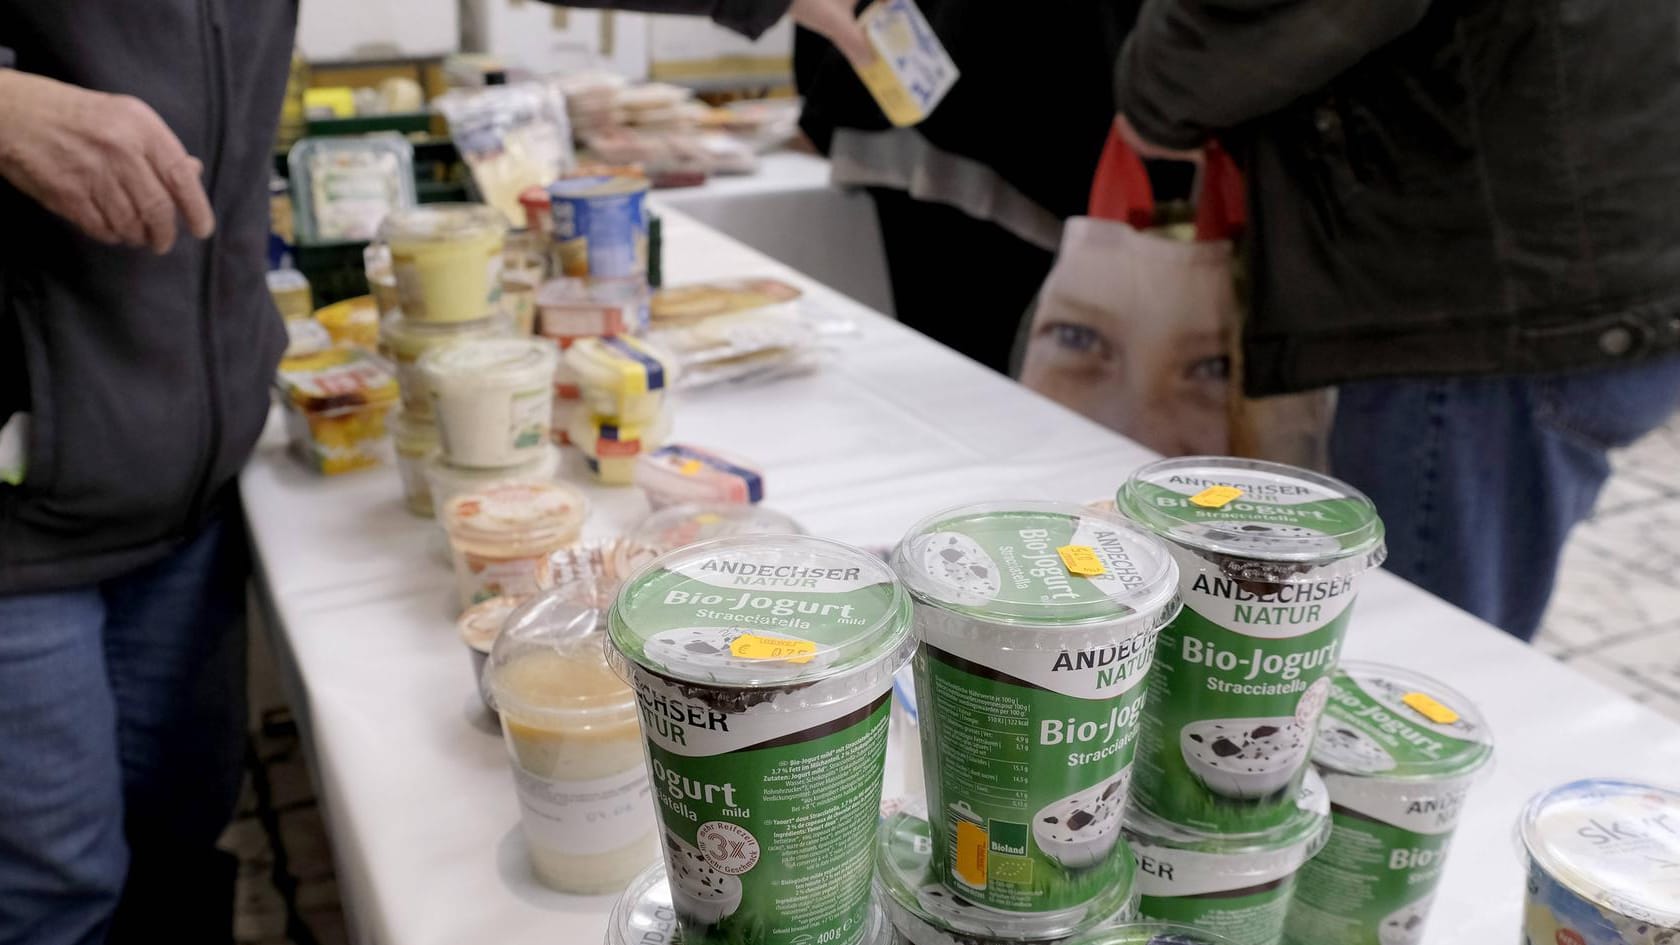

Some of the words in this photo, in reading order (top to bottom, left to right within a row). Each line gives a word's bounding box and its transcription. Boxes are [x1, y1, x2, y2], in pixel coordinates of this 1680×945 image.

[1169, 475, 1310, 496] ANDHSER
[699, 558, 862, 581] ANDECHSER
[999, 545, 1028, 590] Stracciatella
[1018, 528, 1082, 600] Bio-Jogurt
[731, 575, 818, 589] NATUR
[662, 589, 856, 621] Bio-Jogurt
[1233, 603, 1322, 626] NATUR
[695, 608, 812, 631] Stracciatella
[836, 616, 867, 627] mild
[1181, 634, 1340, 681] Bio-Jogurt
[1206, 676, 1307, 696] Stracciatella
[722, 807, 751, 819] mild
[991, 841, 1025, 855] Bioland
